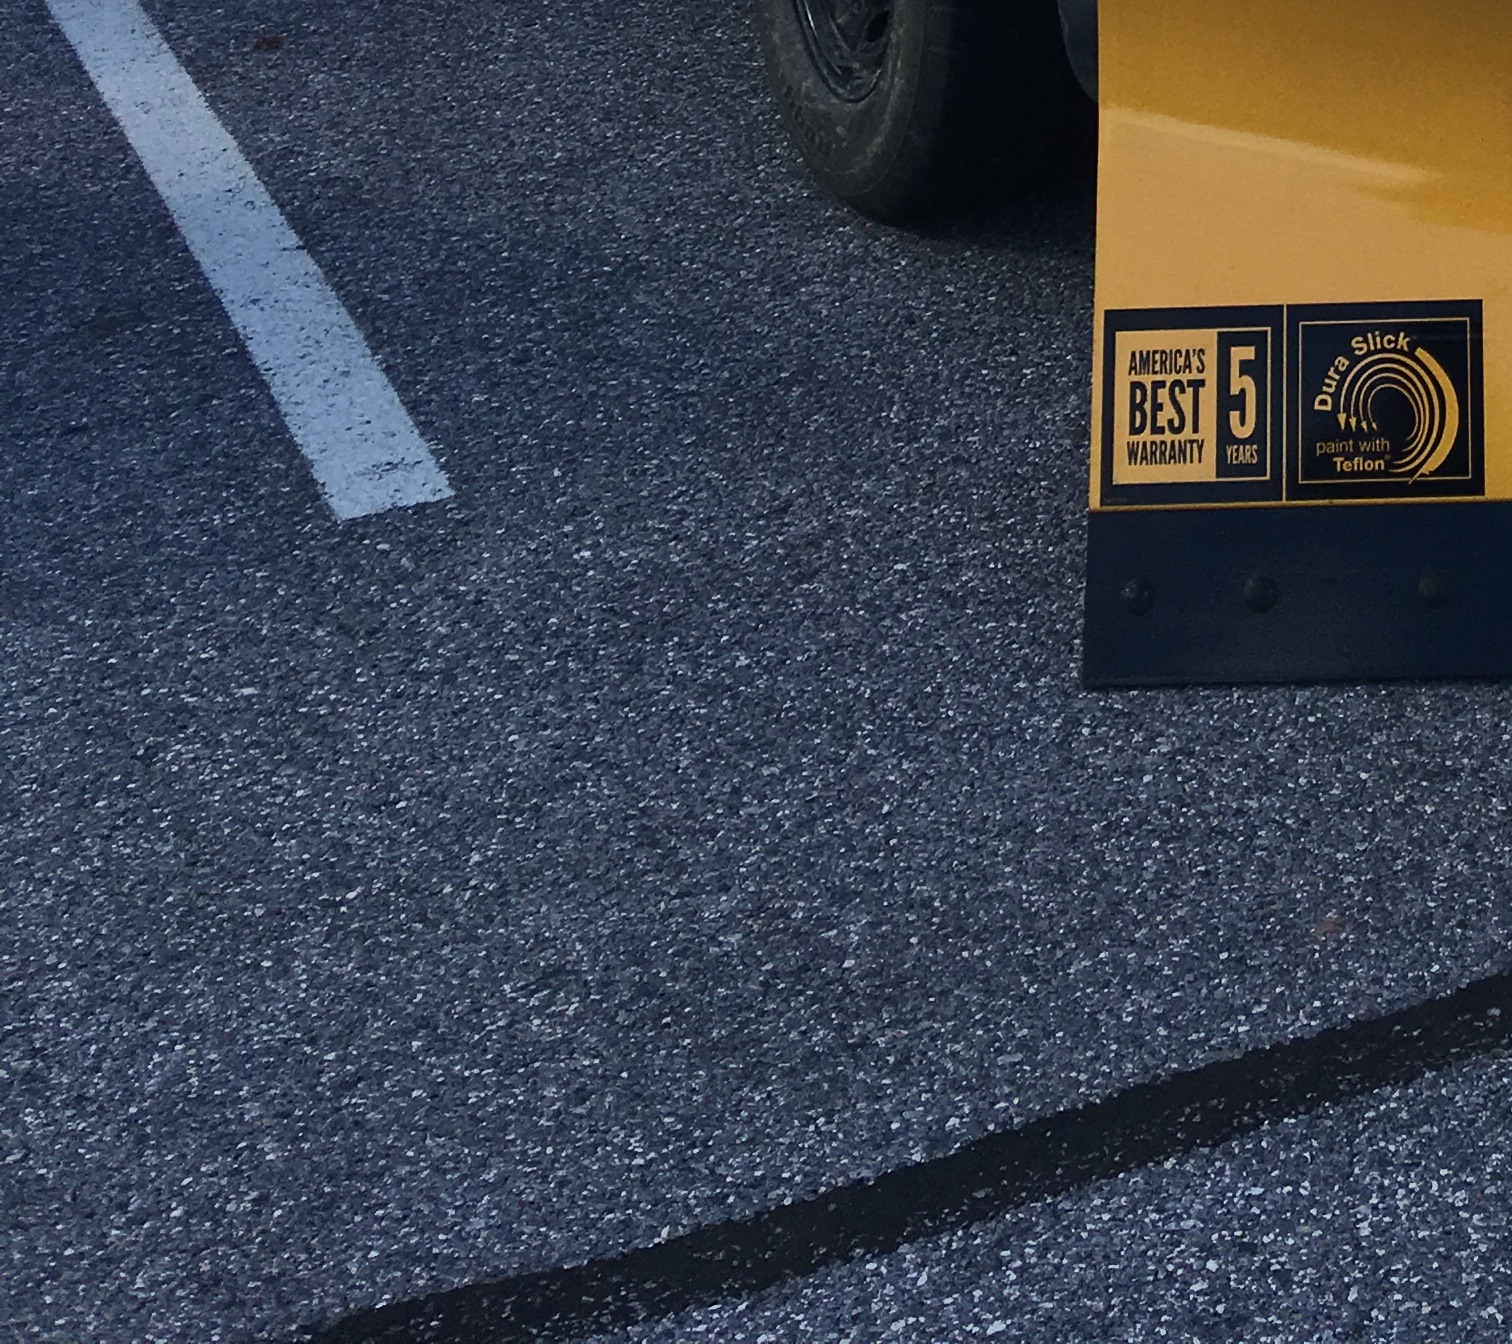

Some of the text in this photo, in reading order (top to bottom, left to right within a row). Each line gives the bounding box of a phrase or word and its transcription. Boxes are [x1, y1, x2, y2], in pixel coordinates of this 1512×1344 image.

[1128, 348, 1205, 377] AMERICA'S
[1314, 331, 1410, 411] Dura Slick
[1229, 345, 1257, 439] 5
[1129, 379, 1206, 436] BEST
[1127, 439, 1204, 466] WARRANTY
[1226, 444, 1258, 465] YEARS
[1316, 437, 1390, 456] paint with
[1332, 456, 1384, 472] Teflon
